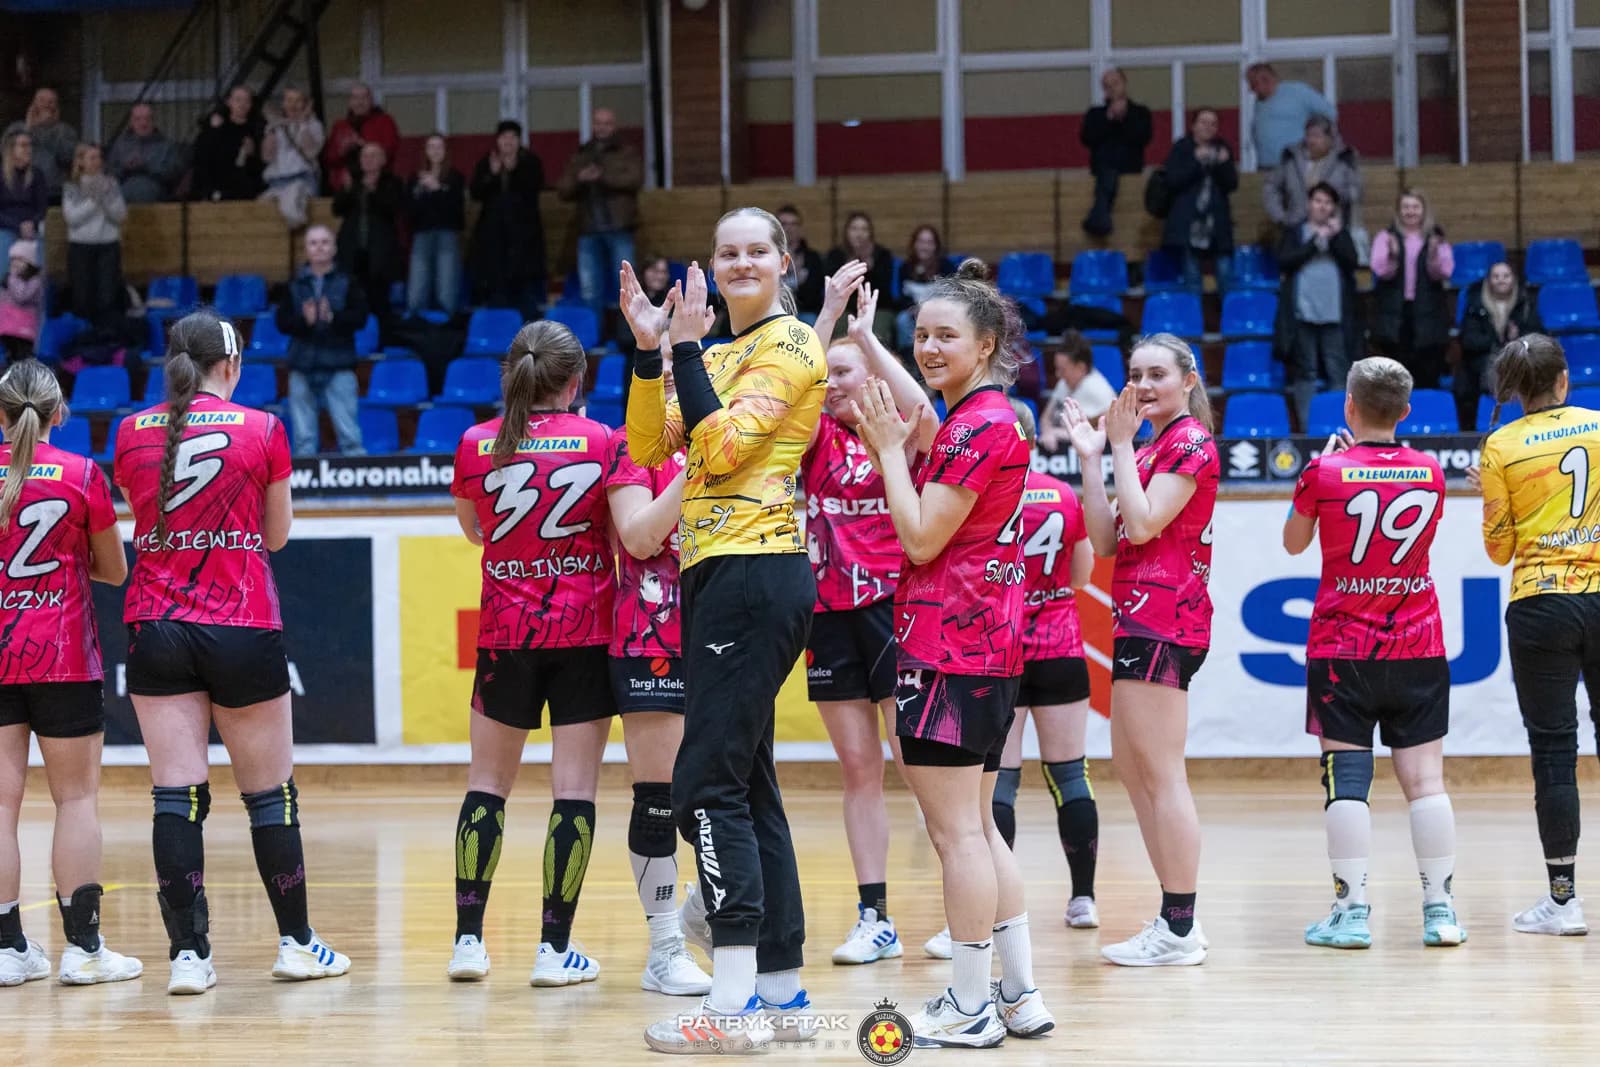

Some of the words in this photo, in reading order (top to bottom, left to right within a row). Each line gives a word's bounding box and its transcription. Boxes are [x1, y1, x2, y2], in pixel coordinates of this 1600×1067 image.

[518, 439, 581, 451] WIATAN
[1539, 422, 1599, 442] LEWIATAN
[162, 431, 231, 513] 5
[1365, 469, 1428, 480] LEWIATAN
[1558, 445, 1590, 519] 1
[483, 460, 603, 543] 32
[0, 497, 70, 580] 2
[1345, 489, 1441, 565] 19
[486, 548, 604, 580] BERLIŃSKA
[0, 590, 64, 610] CZYK
[629, 678, 655, 691] Targi
[648, 807, 673, 816] SELECT
